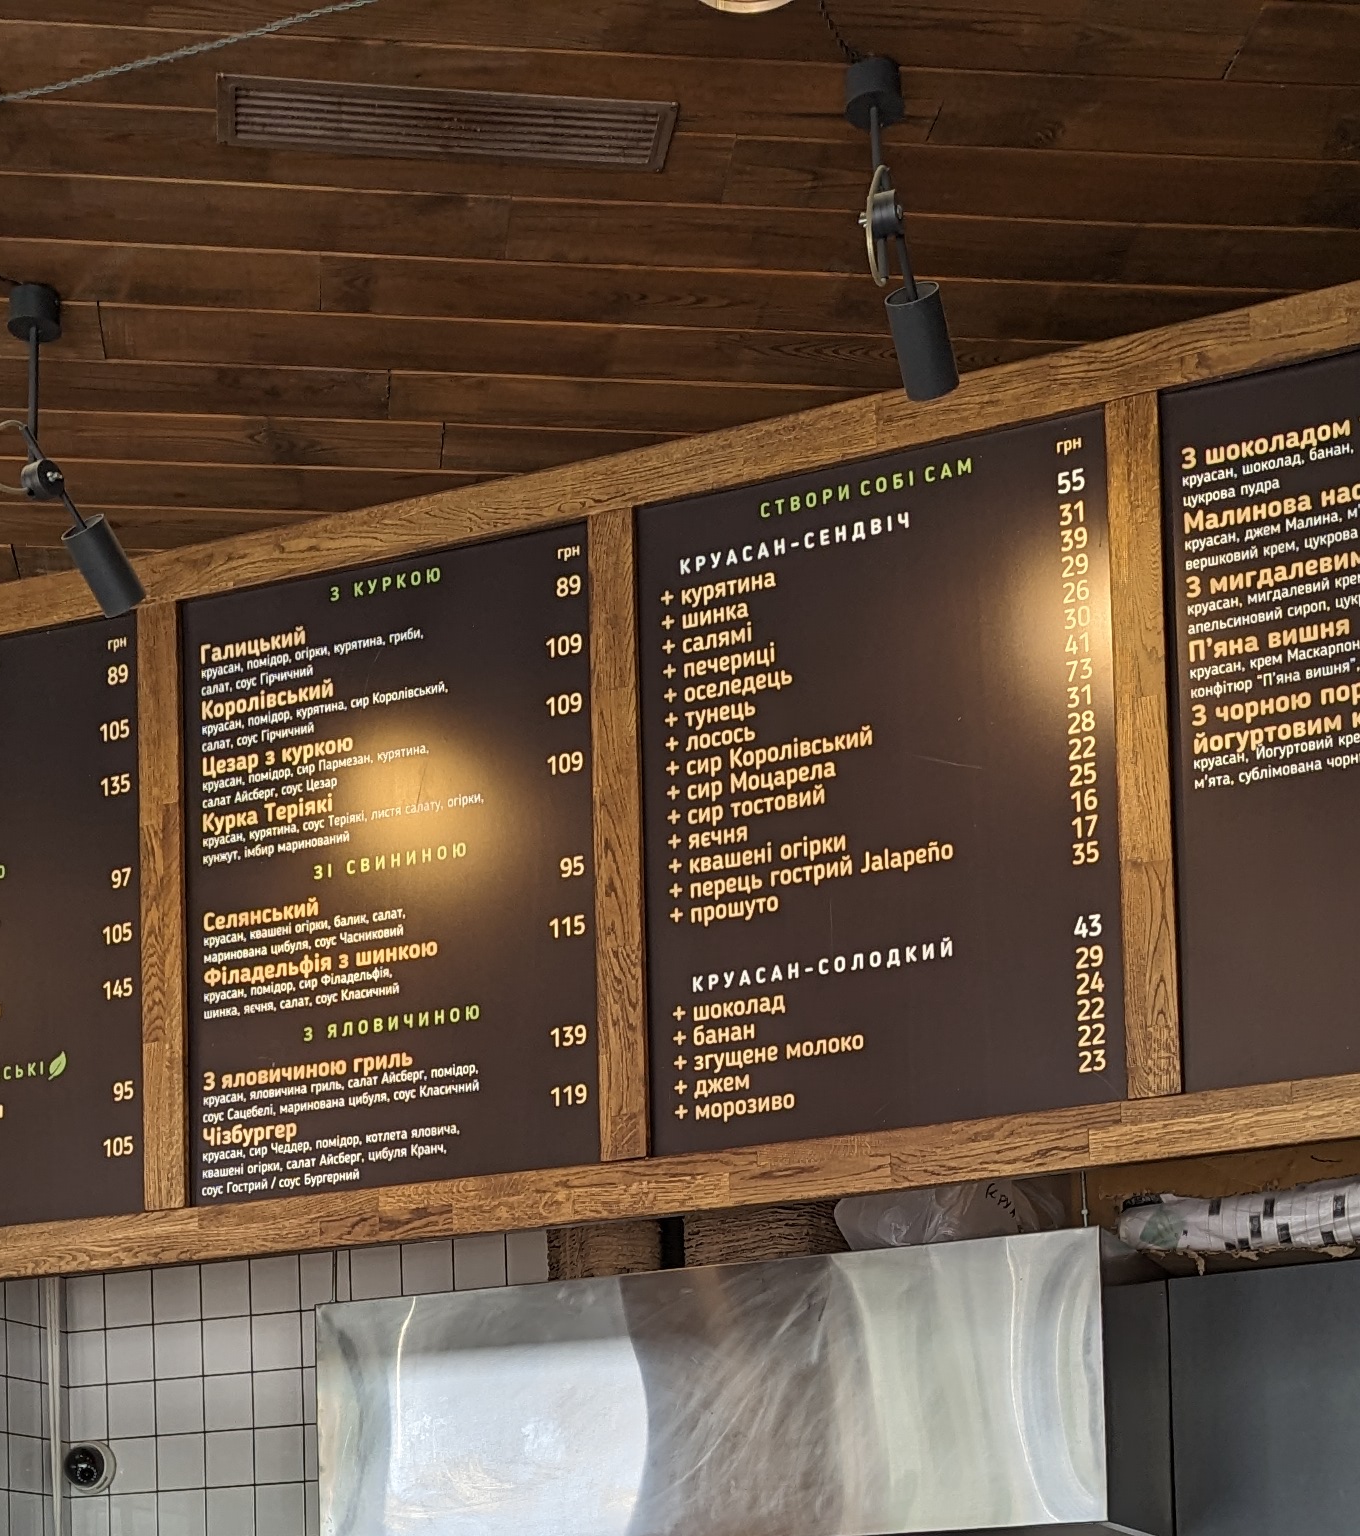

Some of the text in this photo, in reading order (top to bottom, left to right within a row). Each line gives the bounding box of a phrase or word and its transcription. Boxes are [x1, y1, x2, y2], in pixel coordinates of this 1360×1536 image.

[1204, 417, 1351, 467] шоколадом
[1057, 468, 1085, 494] 55
[1182, 441, 1354, 488] круасан, шоколад, банан,
[760, 458, 973, 519] СТВОРИ СОБІ САМ
[1183, 494, 1311, 535] Малинова
[679, 511, 911, 575] КРУАСАН-СЕНДВІЧ
[353, 567, 441, 598] КУРКОЮ
[556, 575, 581, 598] 89
[680, 570, 776, 607] курятина
[681, 602, 749, 631] шинка
[1267, 617, 1350, 649] вишня
[200, 627, 306, 664] Галицький
[201, 628, 424, 680] круасан, помідор, огірки, курятина, гриби,
[682, 622, 752, 654] салямі
[107, 664, 129, 685] 89
[684, 669, 793, 704] оселедець
[201, 678, 334, 721] Королівський
[202, 734, 353, 778] Цезар з куркою
[202, 793, 333, 834] Курка Теріякі
[689, 875, 763, 901] перець
[770, 855, 853, 889] гострий
[692, 937, 953, 993] КРУАСАН-СОЛОДКИЙ
[550, 1024, 587, 1048] 139
[203, 1122, 297, 1148] Чізбургер
